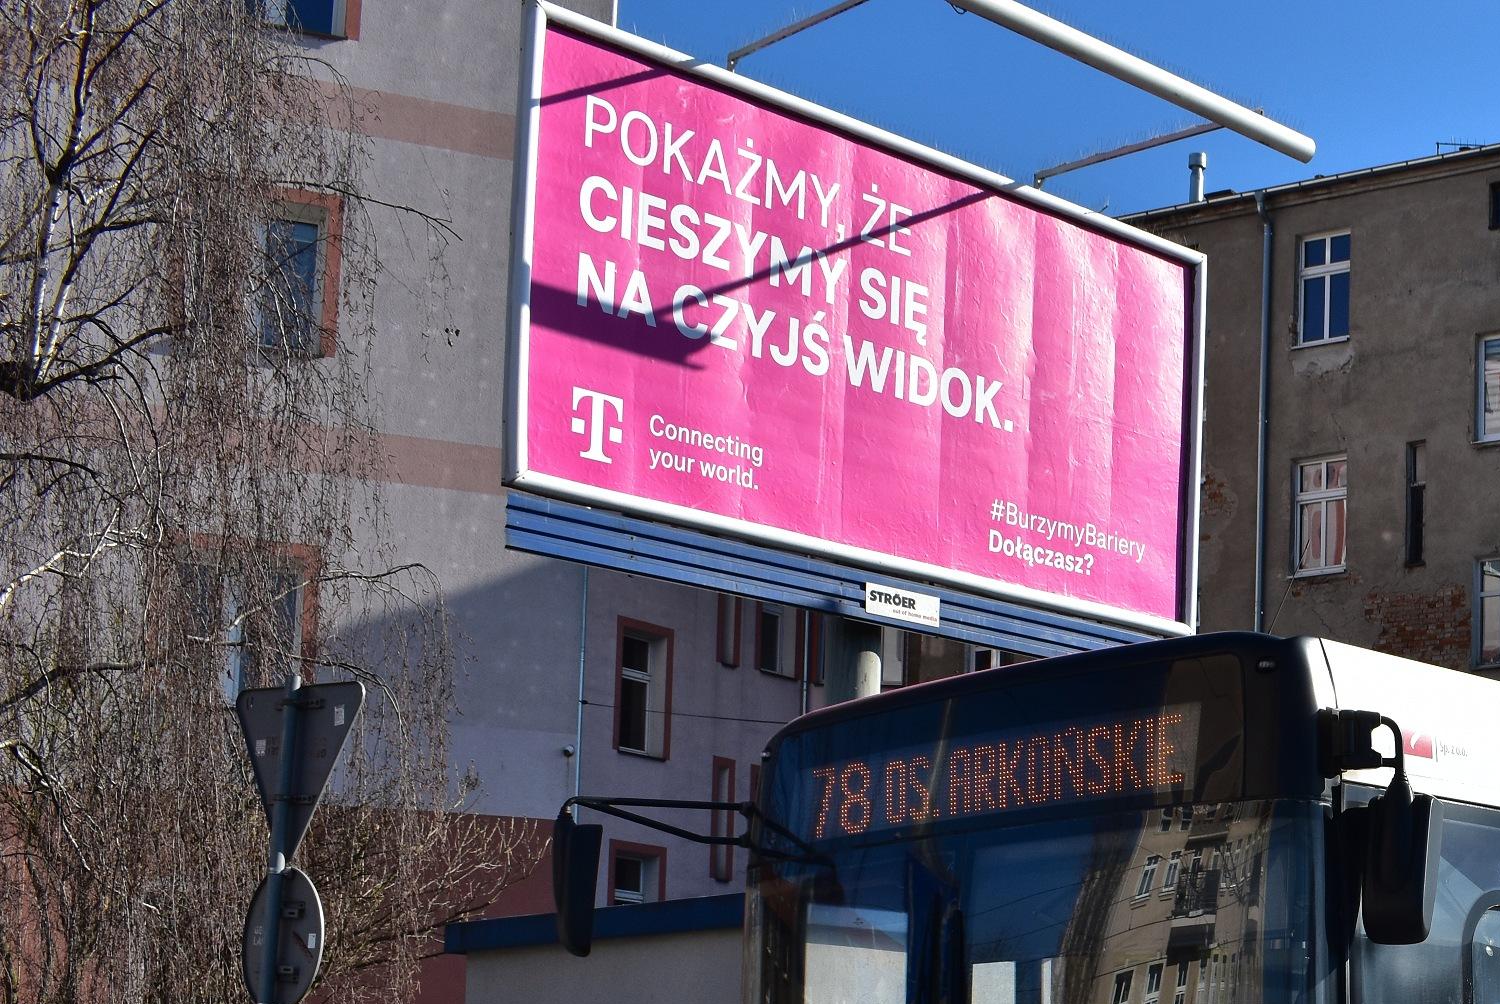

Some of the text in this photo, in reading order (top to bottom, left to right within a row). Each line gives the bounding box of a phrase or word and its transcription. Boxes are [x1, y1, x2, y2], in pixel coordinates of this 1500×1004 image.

[583, 94, 914, 257] POKAŻMY, ŻE
[578, 175, 930, 347] CIESZYMY SIĘ
[575, 252, 1015, 433] NA CZYJŚ WIDOK.
[649, 414, 764, 468] Connecting
[649, 447, 759, 490] your world.
[988, 529, 1095, 576] Dołączasz?
[990, 499, 1146, 564] #BurzymyBariery
[869, 590, 916, 610] STRÖER
[812, 713, 1185, 839] 78 OS. ARKOŃSKIE
